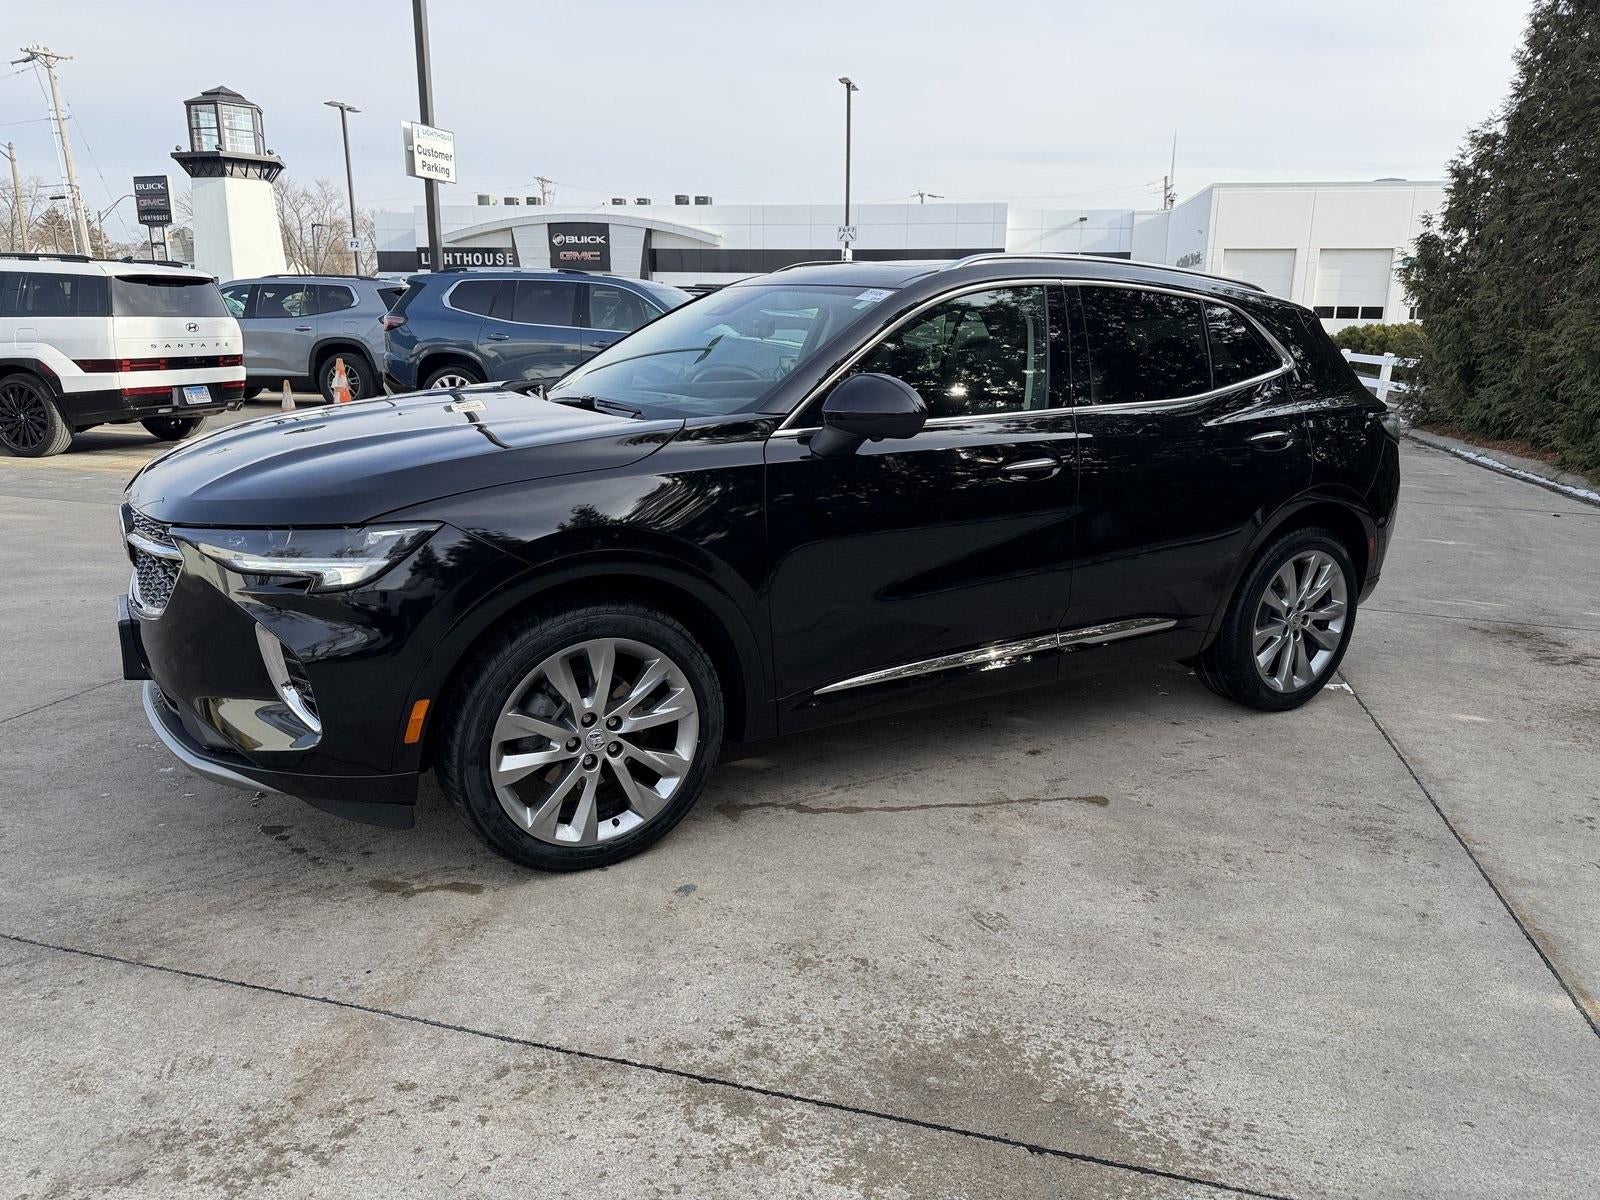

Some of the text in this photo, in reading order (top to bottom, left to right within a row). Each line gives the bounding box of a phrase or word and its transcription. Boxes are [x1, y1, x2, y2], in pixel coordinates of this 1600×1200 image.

[416, 144, 453, 161] Customer
[421, 160, 450, 178] Parking
[139, 198, 166, 206] GMC
[565, 235, 607, 244] BUICK
[421, 252, 514, 266] LHTHOUSE
[559, 250, 601, 261] GMC
